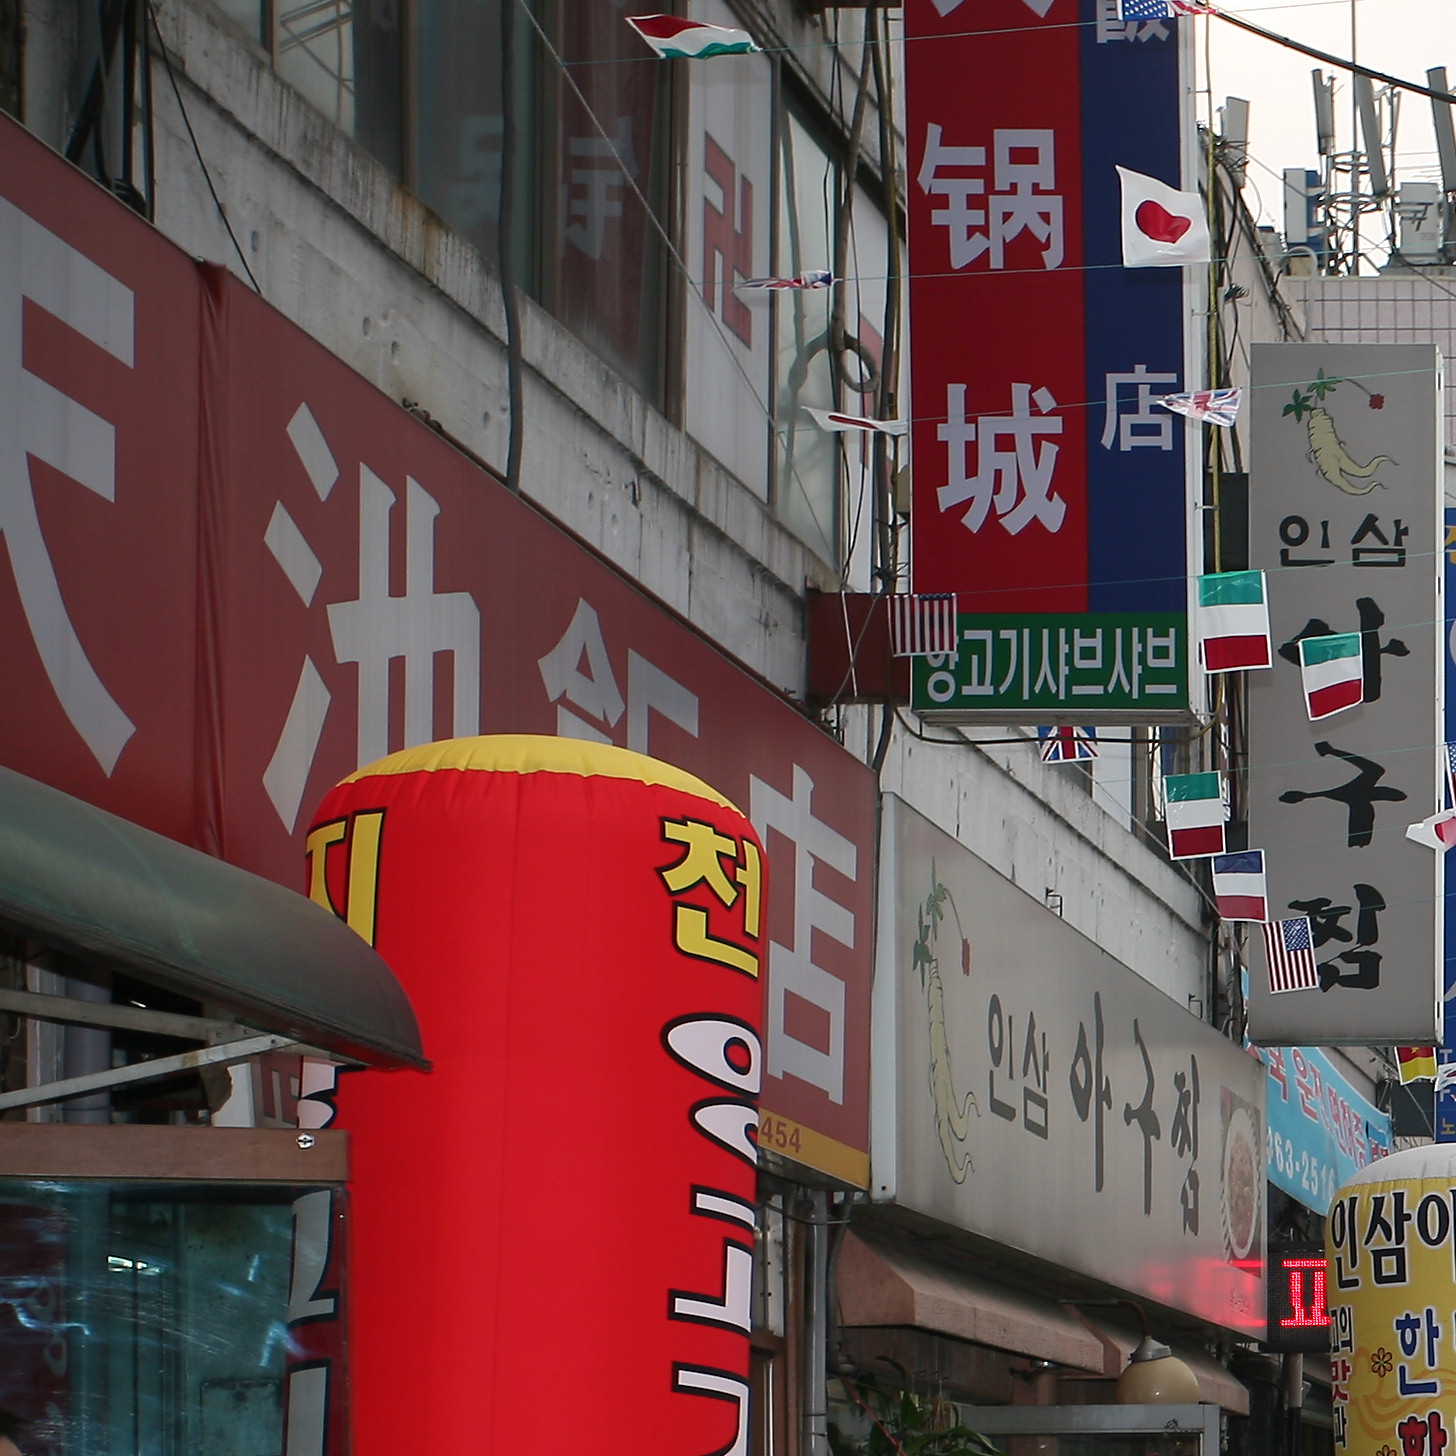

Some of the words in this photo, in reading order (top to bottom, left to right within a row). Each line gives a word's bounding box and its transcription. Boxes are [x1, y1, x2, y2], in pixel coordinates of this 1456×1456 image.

[918, 0, 1067, 536] 锅城
[1279, 514, 1409, 568] 인삼
[1278, 597, 1410, 993] 아구찜
[988, 992, 1050, 1141] 인삼
[1069, 989, 1199, 1236] 아구찜
